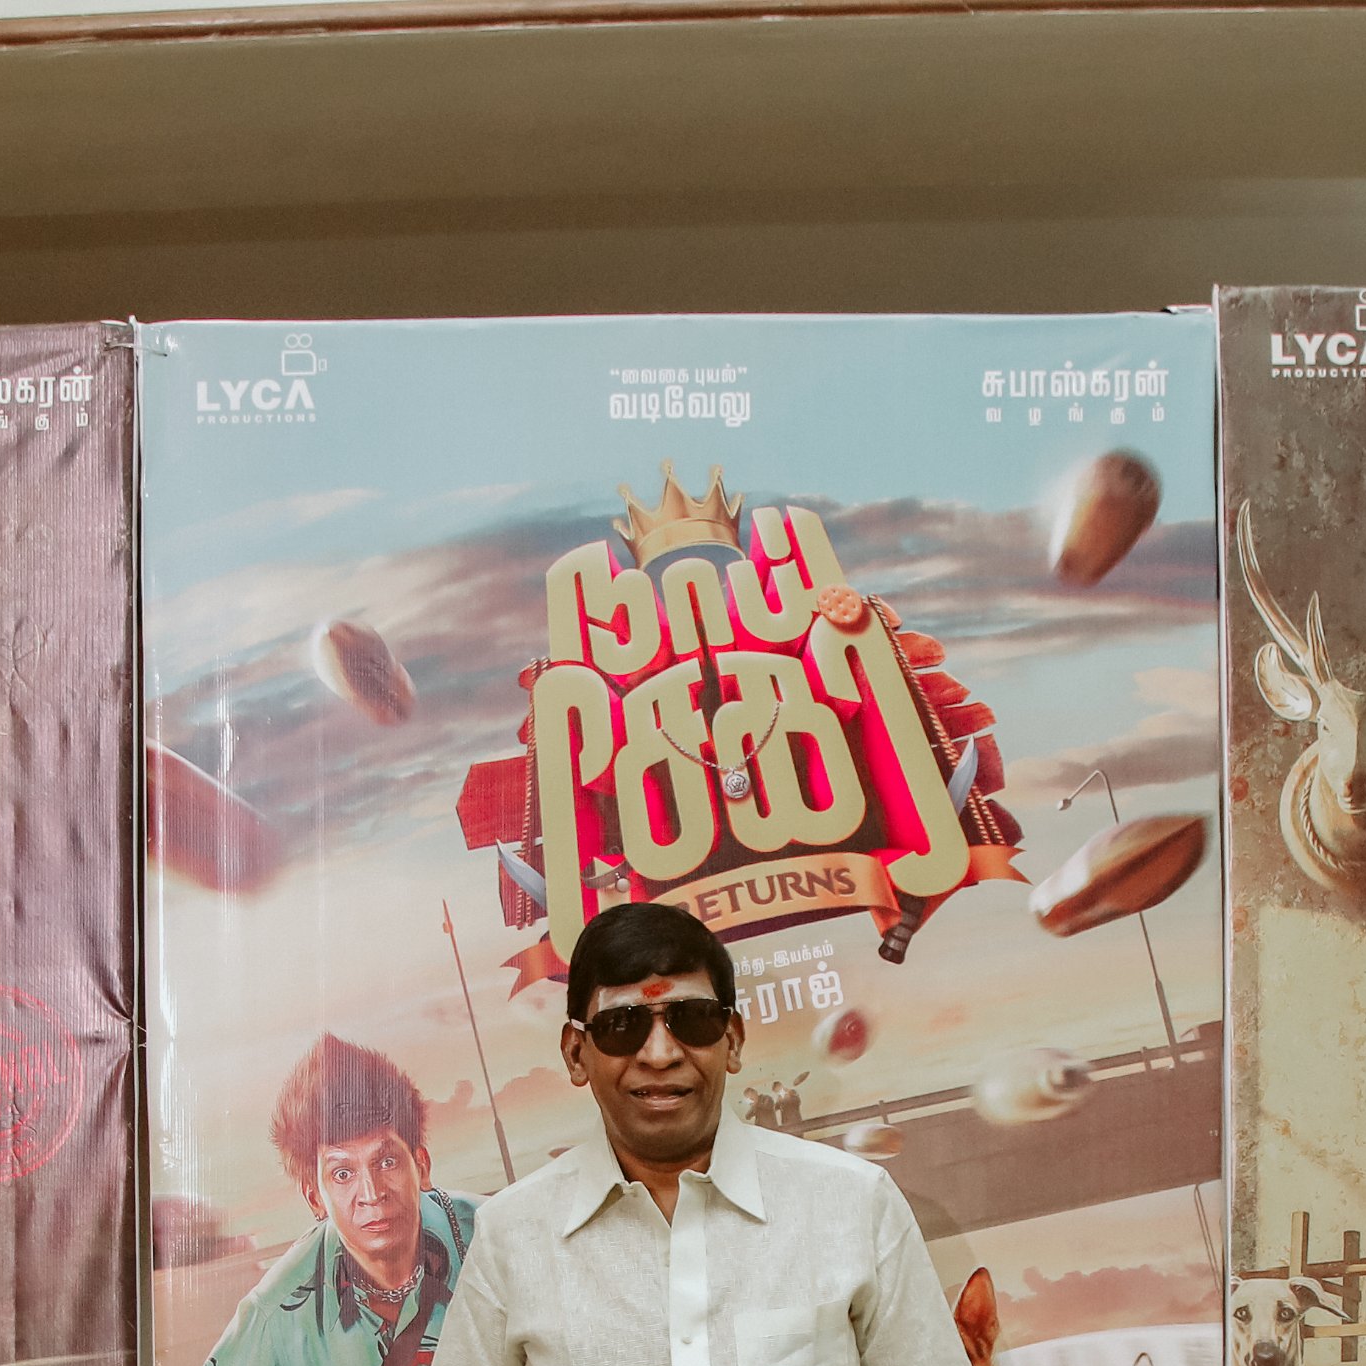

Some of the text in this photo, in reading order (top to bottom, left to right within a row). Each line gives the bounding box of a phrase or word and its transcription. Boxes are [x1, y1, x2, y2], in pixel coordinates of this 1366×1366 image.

[196, 379, 315, 411] LYCA
[982, 360, 1169, 402] சுபாஸ்கரன்
[196, 413, 316, 425] PRODUCTIONS
[609, 385, 751, 428] வடிவேலு
[546, 504, 855, 678] நாய்
[733, 939, 834, 977] த்து-இயக்கம்
